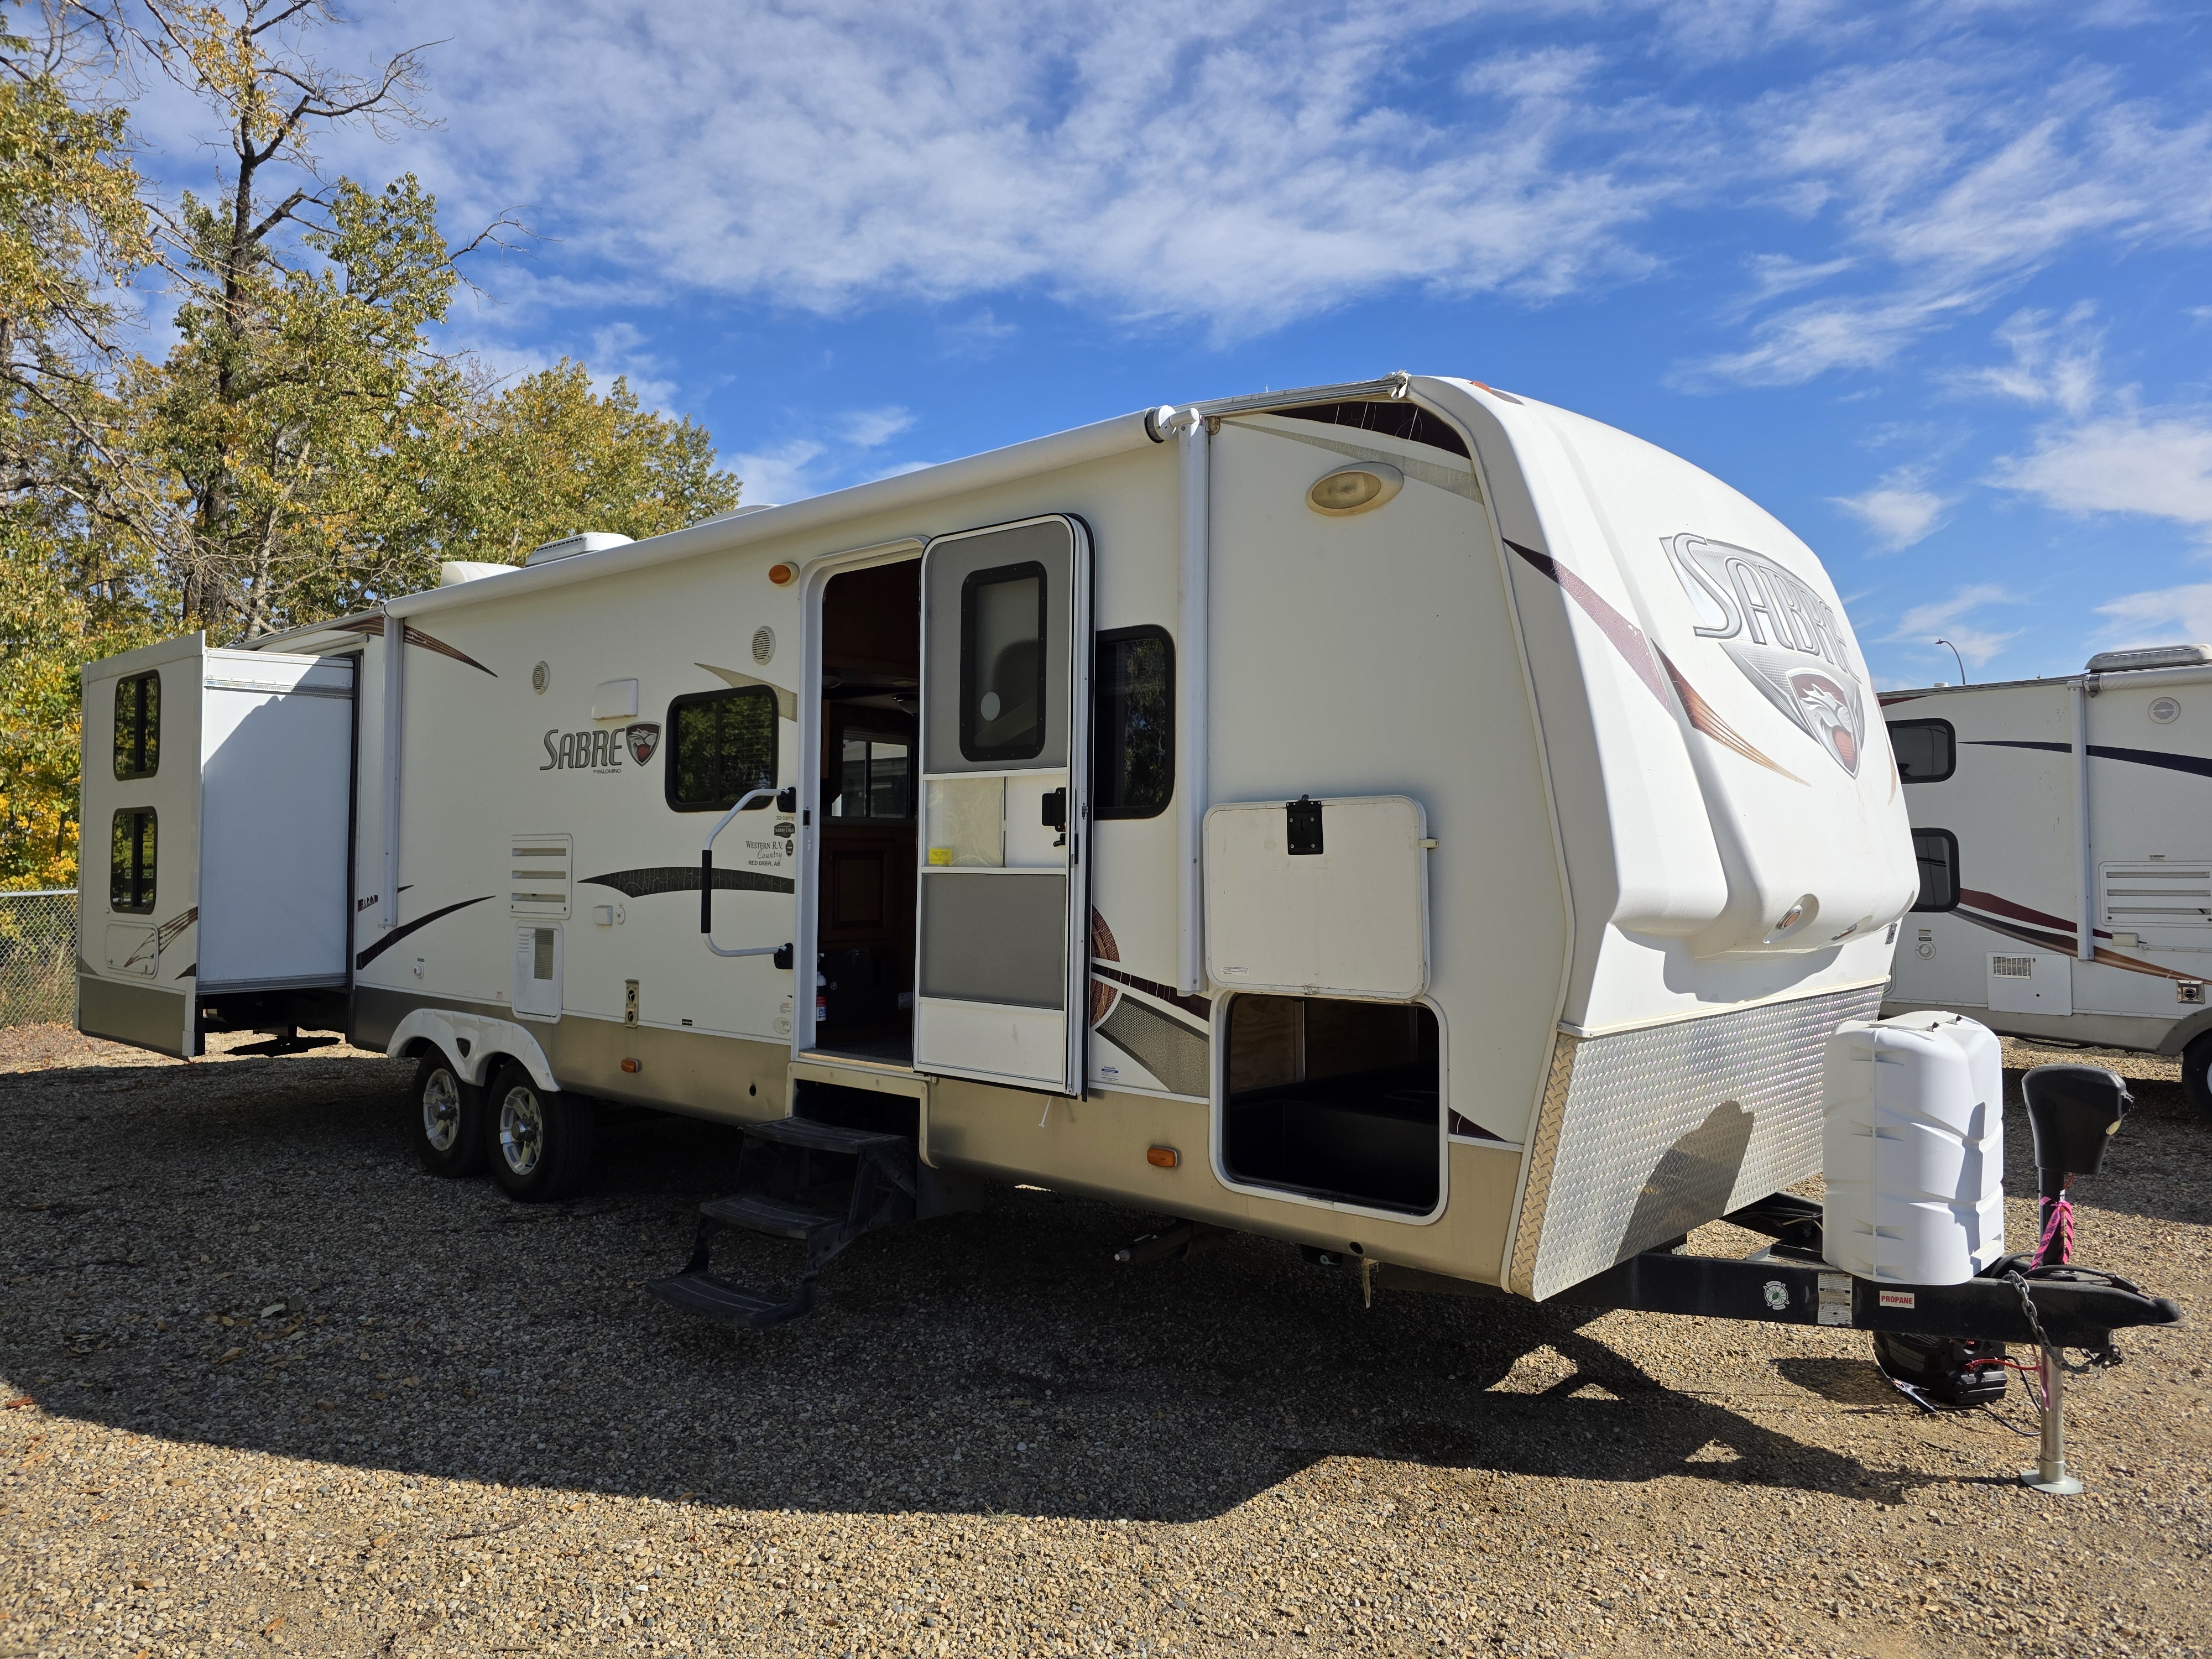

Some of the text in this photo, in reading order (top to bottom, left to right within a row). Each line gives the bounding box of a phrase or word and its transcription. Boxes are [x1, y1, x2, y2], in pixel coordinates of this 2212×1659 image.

[1673, 532, 1862, 685] SABRE
[540, 728, 625, 770] SABRE
[745, 841, 770, 849] WESTERN
[757, 849, 782, 861] Country
[1881, 1295, 1913, 1304] PROPANE
